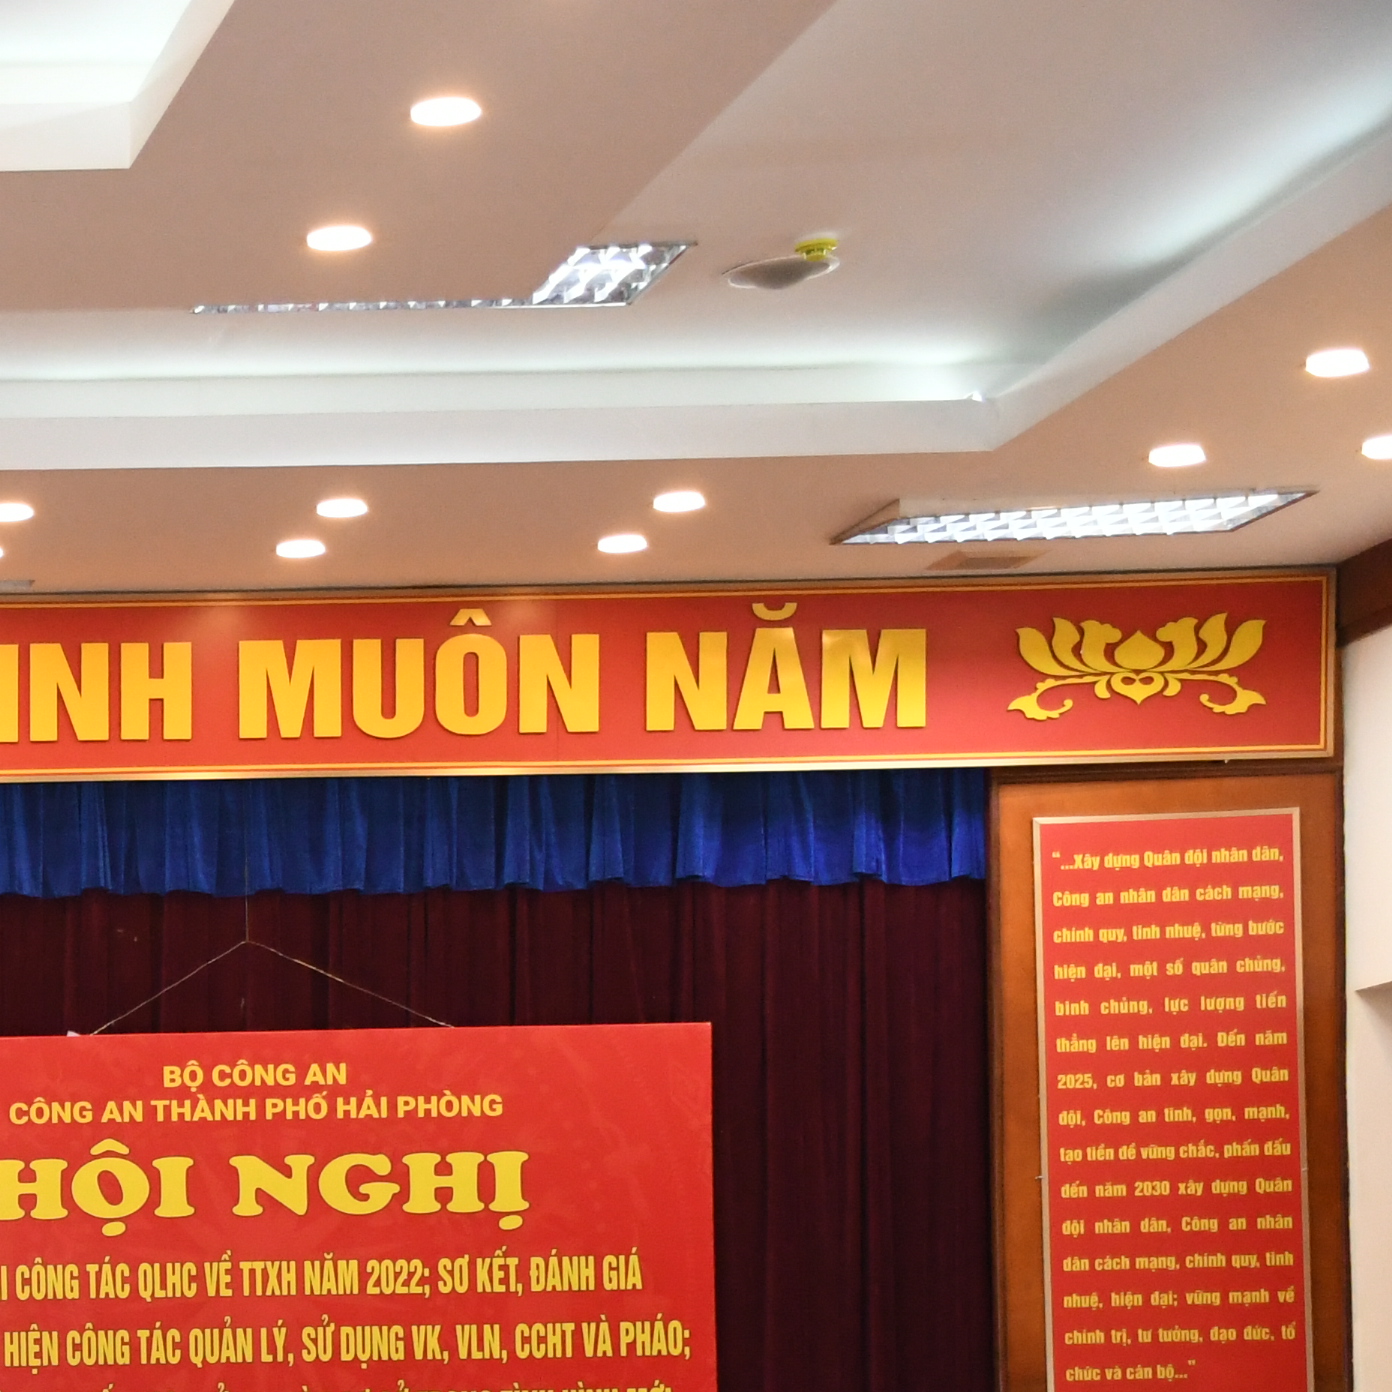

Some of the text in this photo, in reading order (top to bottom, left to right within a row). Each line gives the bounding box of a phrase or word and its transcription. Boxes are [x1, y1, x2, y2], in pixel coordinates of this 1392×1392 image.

[239, 609, 599, 738] MUÔN
[647, 604, 926, 730] NĂM
[1053, 885, 1283, 907] Công an nhân dân cách mạng,
[164, 1060, 346, 1096] BỘ CÔNG AN
[1058, 1074, 1097, 1089] 2025,
[1107, 1074, 1124, 1087] cơ
[1171, 1070, 1196, 1086] xây
[1207, 1069, 1241, 1086] dựng
[1252, 1067, 1288, 1083] Quân
[10, 1090, 502, 1124] CÔNG AN THÀNH PHỐ HẢI PHÒNG
[229, 1151, 529, 1229] NGHỊ
[16, 1258, 79, 1300] CÔNG
[86, 1256, 130, 1298] TÁC
[138, 1262, 196, 1302] QLHC
[204, 1250, 232, 1296] VỀ
[240, 1261, 296, 1296] TTXH
[304, 1253, 358, 1295] NĂM
[367, 1259, 430, 1298] 2022;
[438, 1255, 469, 1293] SƠ
[477, 1246, 522, 1296] KẾT,
[530, 1249, 594, 1291] ĐÁNH
[603, 1247, 642, 1290] GIÁ
[5, 1324, 58, 1374] HIỆN
[67, 1323, 130, 1365] CÔNG
[137, 1322, 181, 1364] TÁC
[189, 1317, 252, 1367] QUẢN
[261, 1320, 293, 1366] LÝ,
[302, 1315, 335, 1361] SỬ
[341, 1325, 404, 1368] DỤNG
[412, 1325, 448, 1364] VK,
[456, 1324, 507, 1363] VLN,
[515, 1323, 575, 1358] CCHT
[582, 1315, 612, 1357] VÀ
[620, 1313, 690, 1359] PHÁO;
